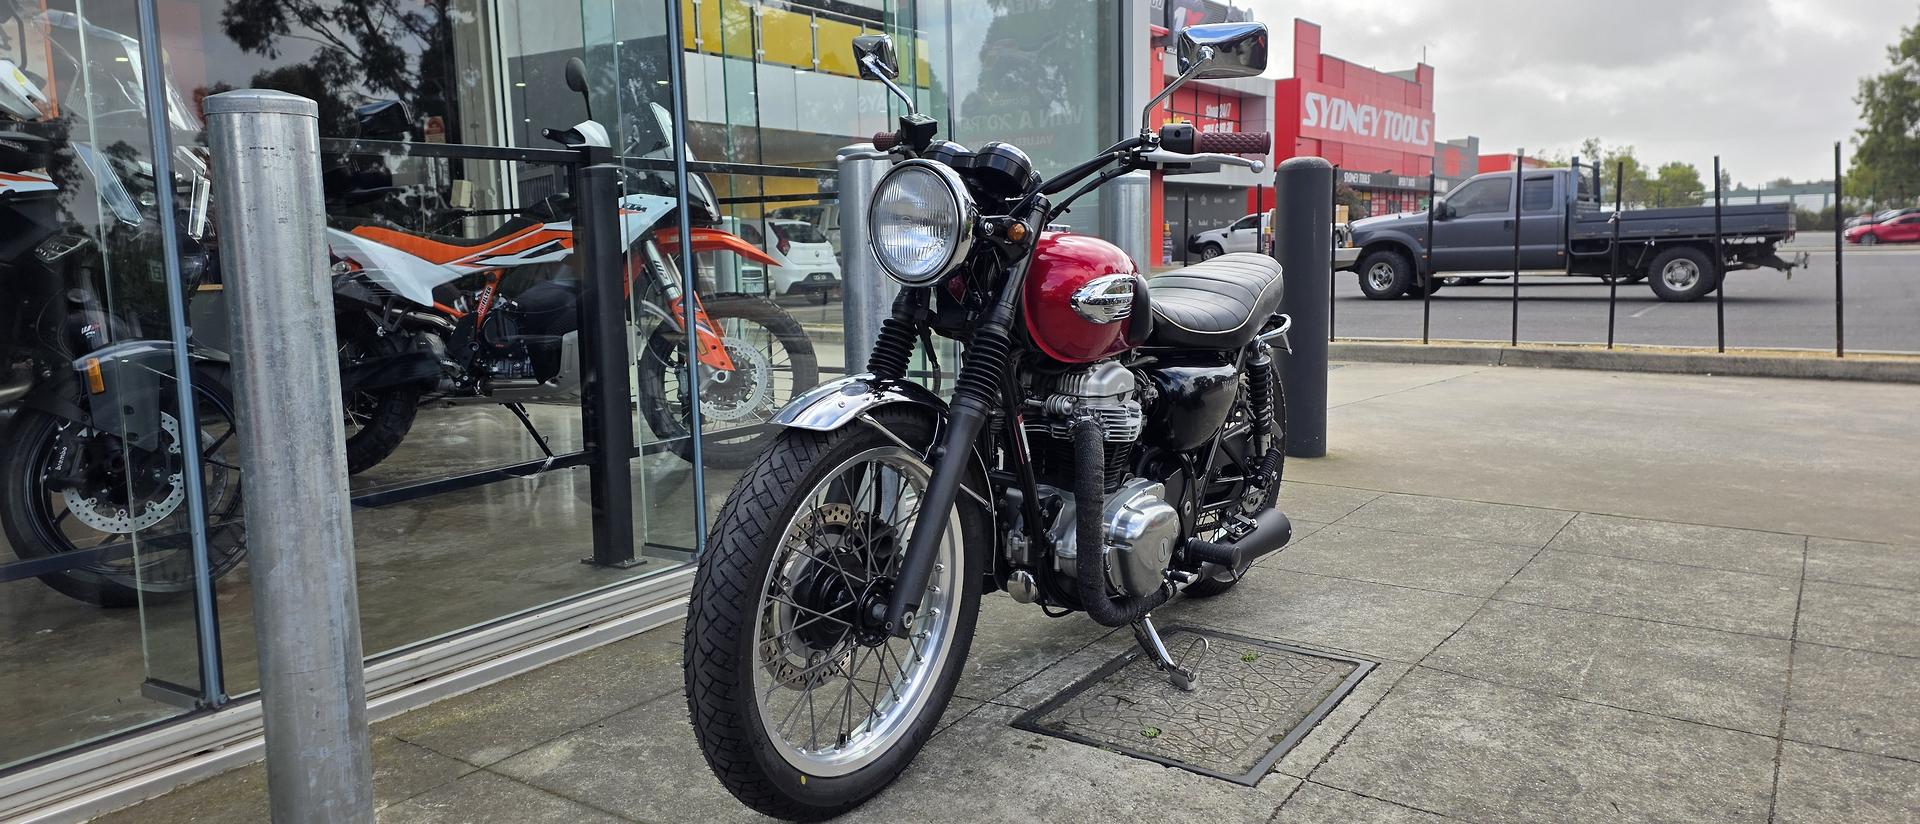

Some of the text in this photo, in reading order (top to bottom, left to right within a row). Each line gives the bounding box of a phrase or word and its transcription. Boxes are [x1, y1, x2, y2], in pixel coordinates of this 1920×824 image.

[1302, 91, 1431, 146] SYDNEY TOOLS
[55, 446, 68, 471] brembo
